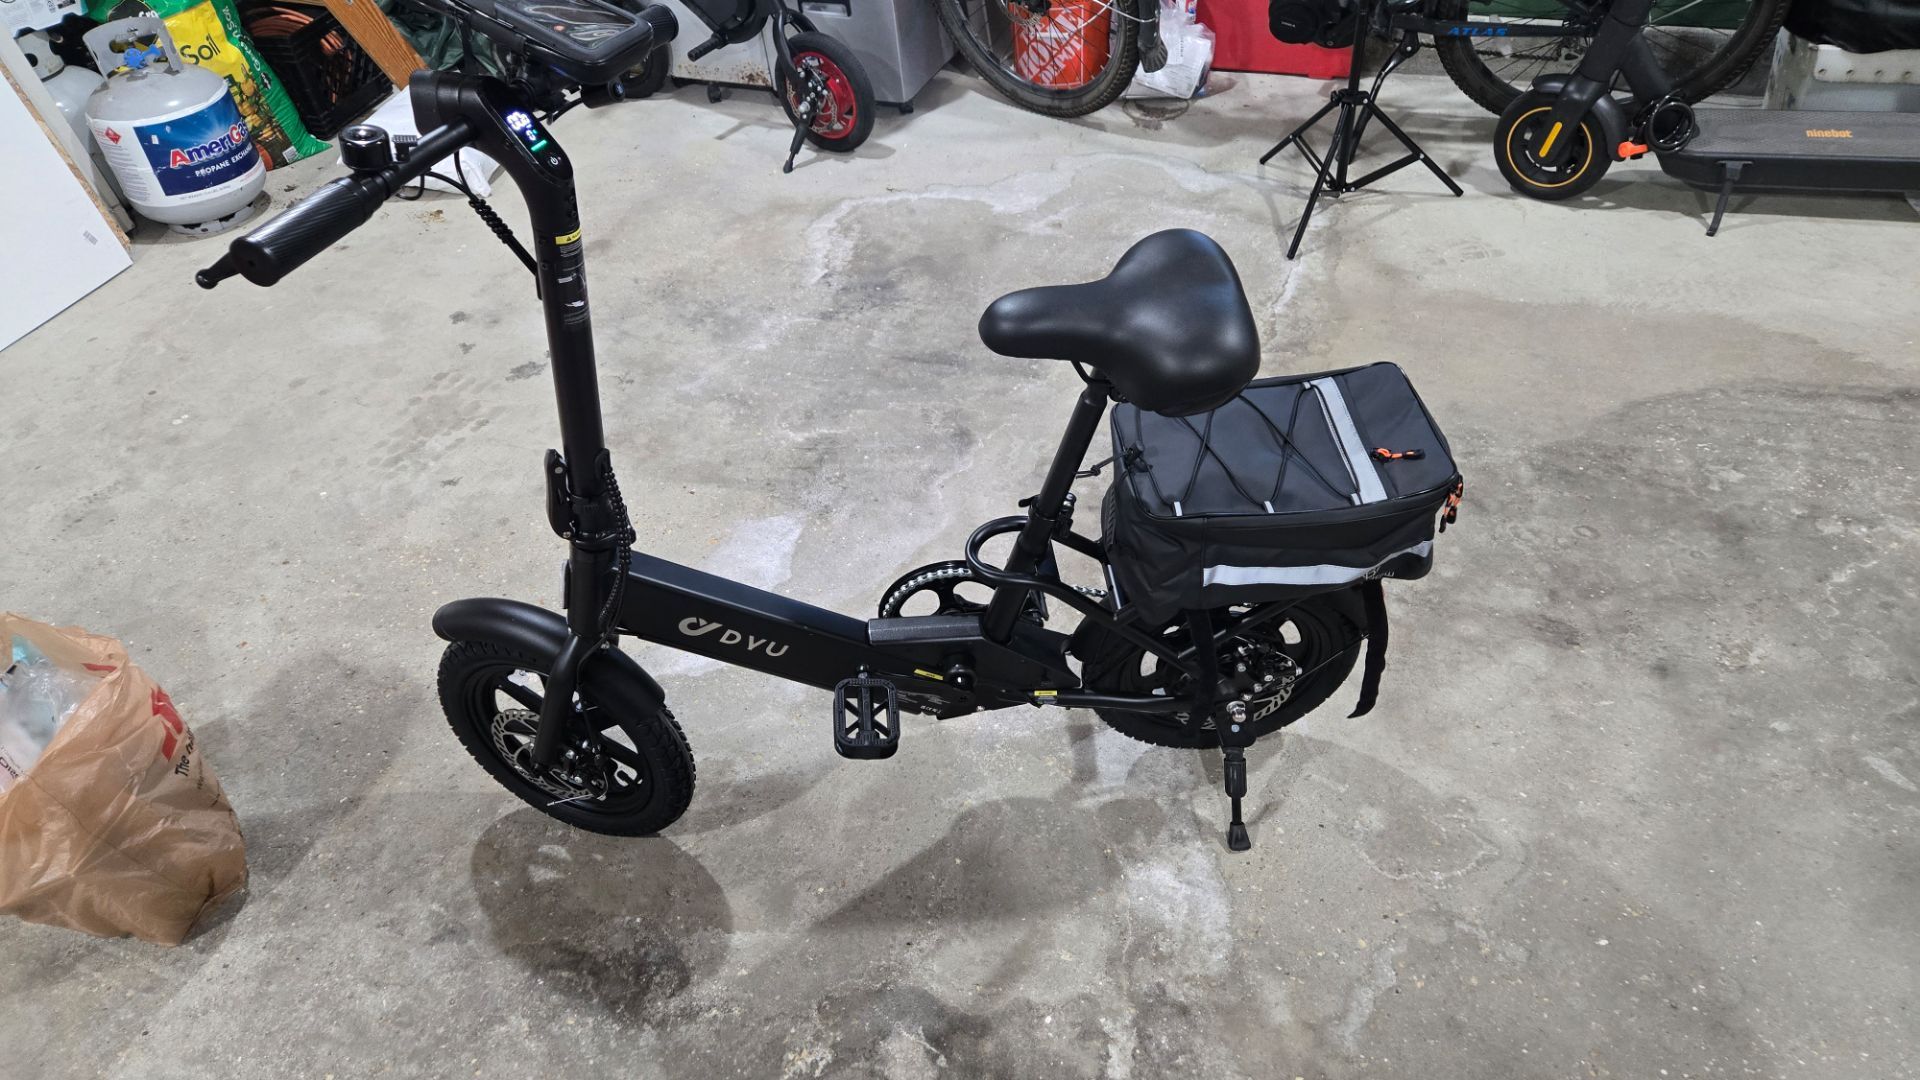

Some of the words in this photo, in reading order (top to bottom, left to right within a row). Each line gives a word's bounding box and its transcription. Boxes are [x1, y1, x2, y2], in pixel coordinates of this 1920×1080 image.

[179, 33, 221, 65] Soil
[1018, 8, 1083, 81] HOME
[1040, 35, 1082, 85] DEPOT
[1806, 128, 1854, 138] ninebot
[195, 159, 231, 177] PROPANE
[174, 755, 190, 777] The
